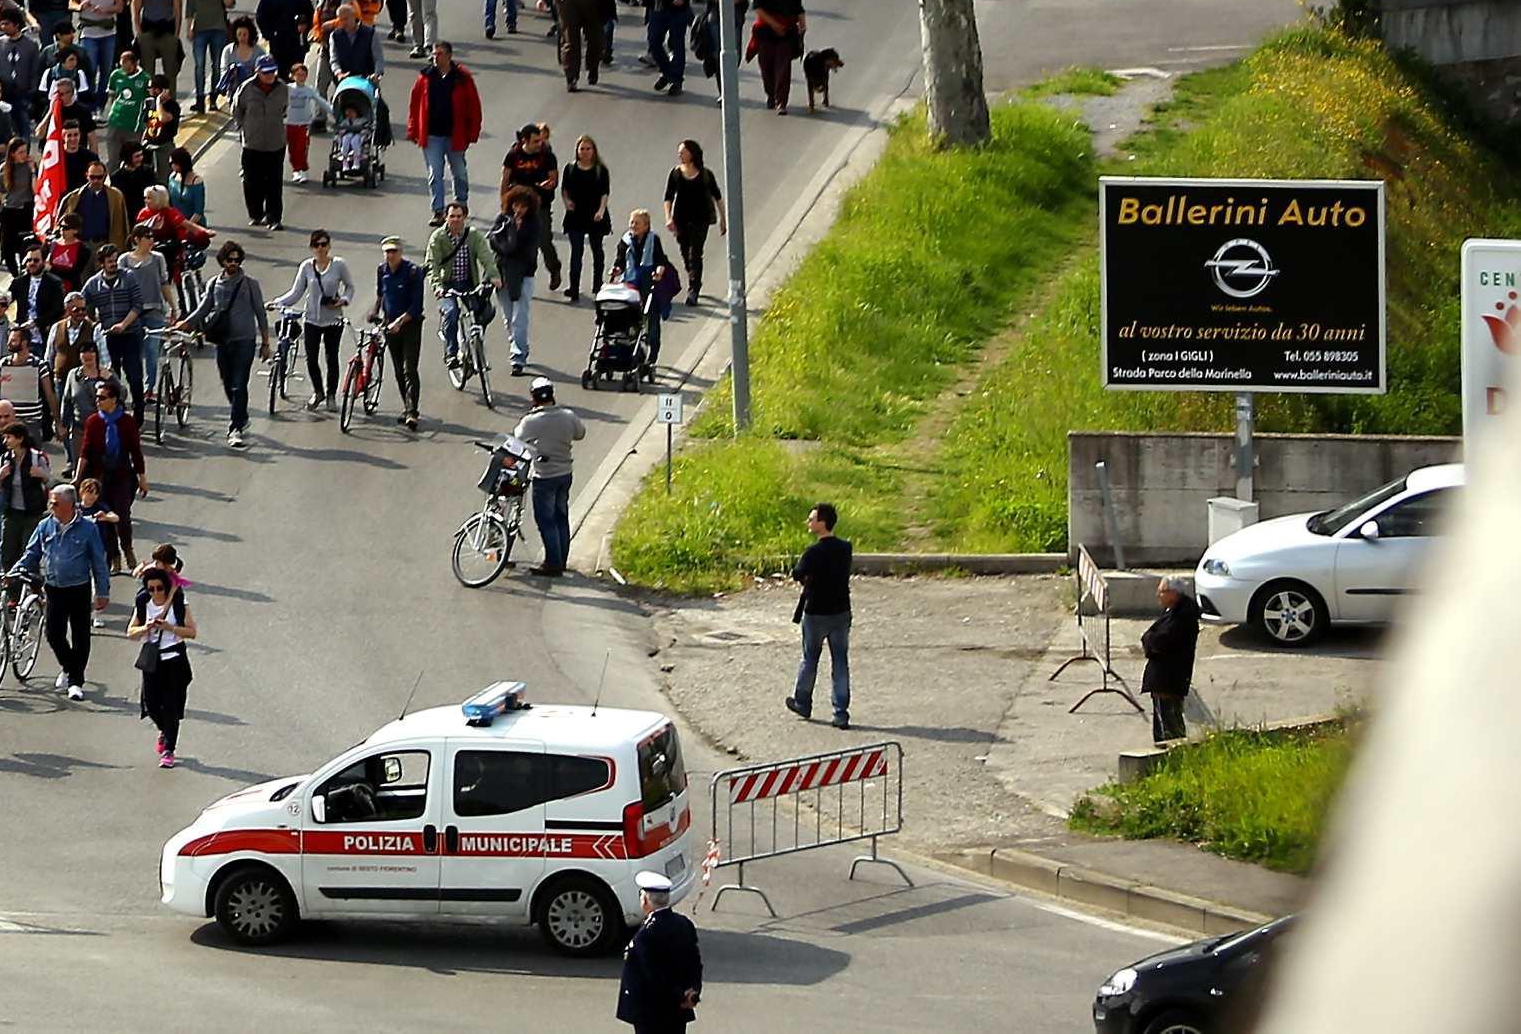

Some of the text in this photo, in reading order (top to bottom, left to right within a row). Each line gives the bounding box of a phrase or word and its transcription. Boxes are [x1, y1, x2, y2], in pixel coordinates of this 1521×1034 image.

[1117, 194, 1367, 228] Ballerini Auto
[1119, 320, 1366, 341] al vostro servizio da 30 anni
[1148, 352, 1174, 363] zona
[1284, 350, 1301, 362] Tel.
[1303, 351, 1322, 363] 055
[1113, 367, 1252, 381] Strada Parco della Marinella
[1273, 369, 1373, 382] www.balleriniauto.it
[288, 804, 300, 815] 12
[344, 835, 573, 854] POLIZIA MUNICIPALE
